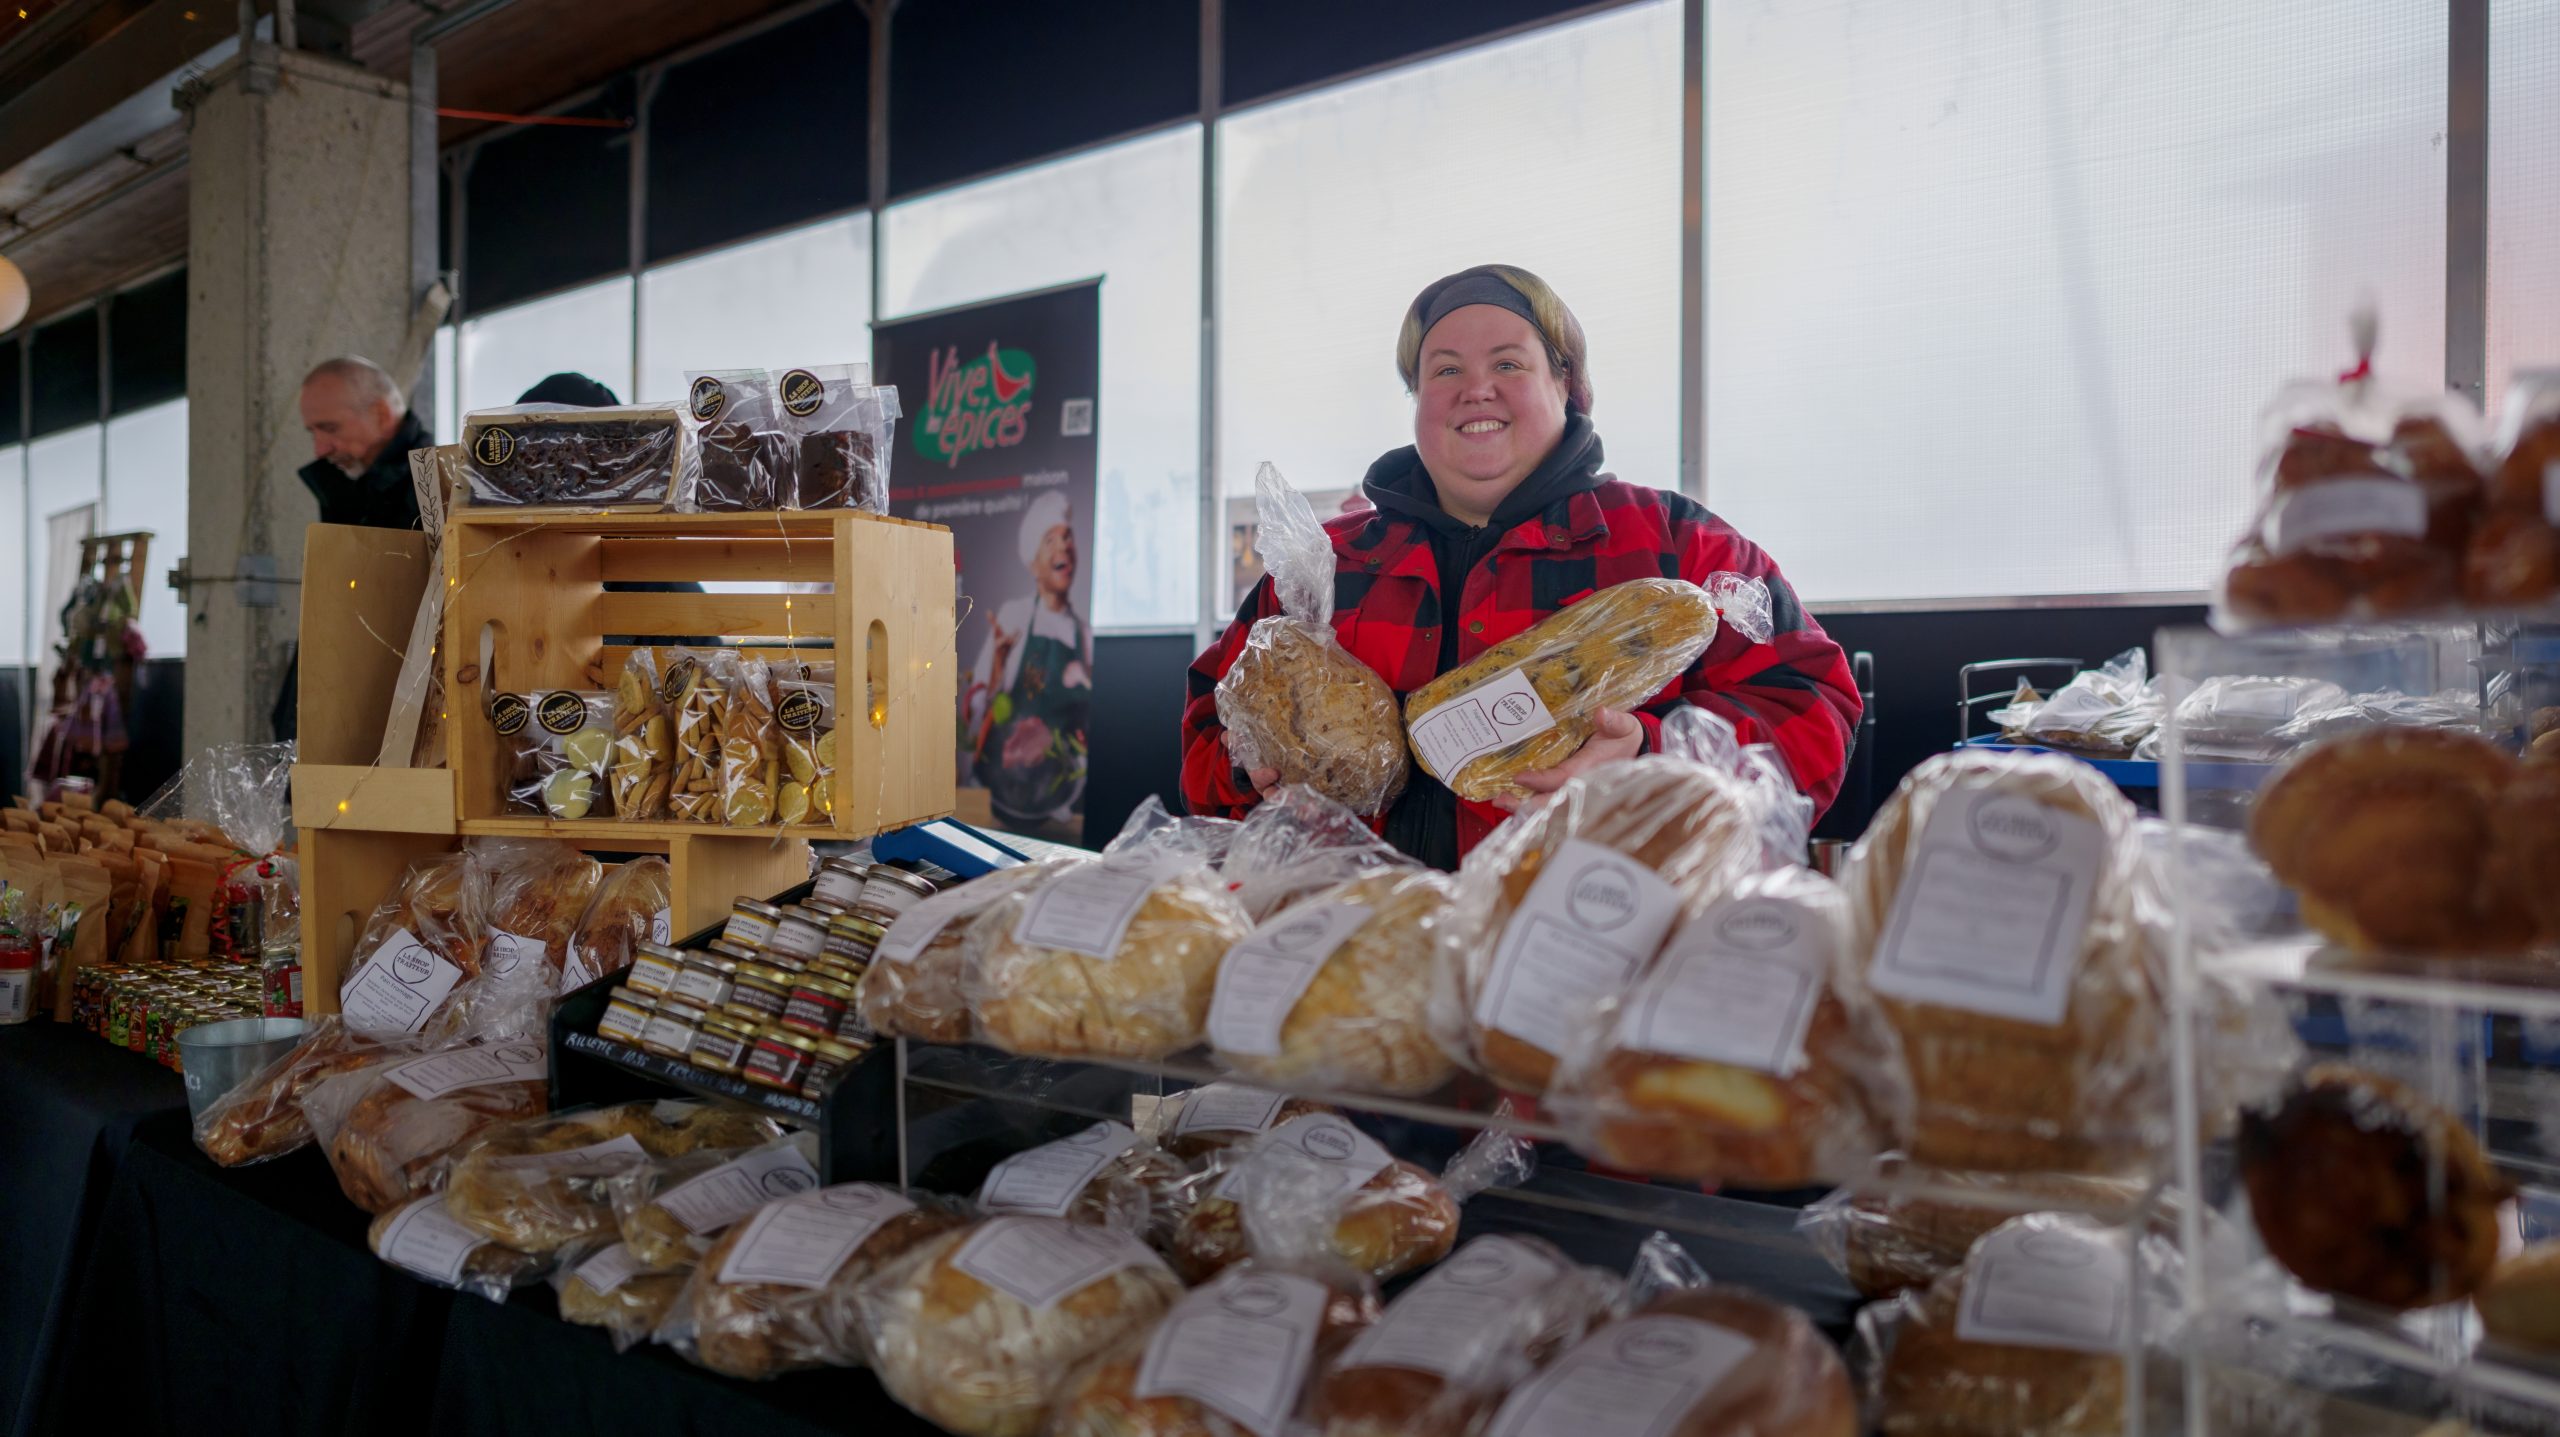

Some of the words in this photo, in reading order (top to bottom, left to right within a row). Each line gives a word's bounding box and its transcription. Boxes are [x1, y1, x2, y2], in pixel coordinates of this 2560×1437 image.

[789, 391, 798, 401] LA
[796, 379, 810, 394] SHOP
[495, 711, 503, 721] LA
[502, 702, 518, 716] SHOP
[545, 710, 556, 719] LA
[556, 700, 573, 712] SHOP
[547, 703, 581, 725] TRAITEUR
[1501, 699, 1524, 722] TRAITEUR
[1507, 697, 1516, 706] LA
[1514, 703, 1528, 716] SHOP
[396, 957, 431, 976] TRAITEUR
[402, 952, 413, 962] LA
[412, 957, 430, 968] SHOP
